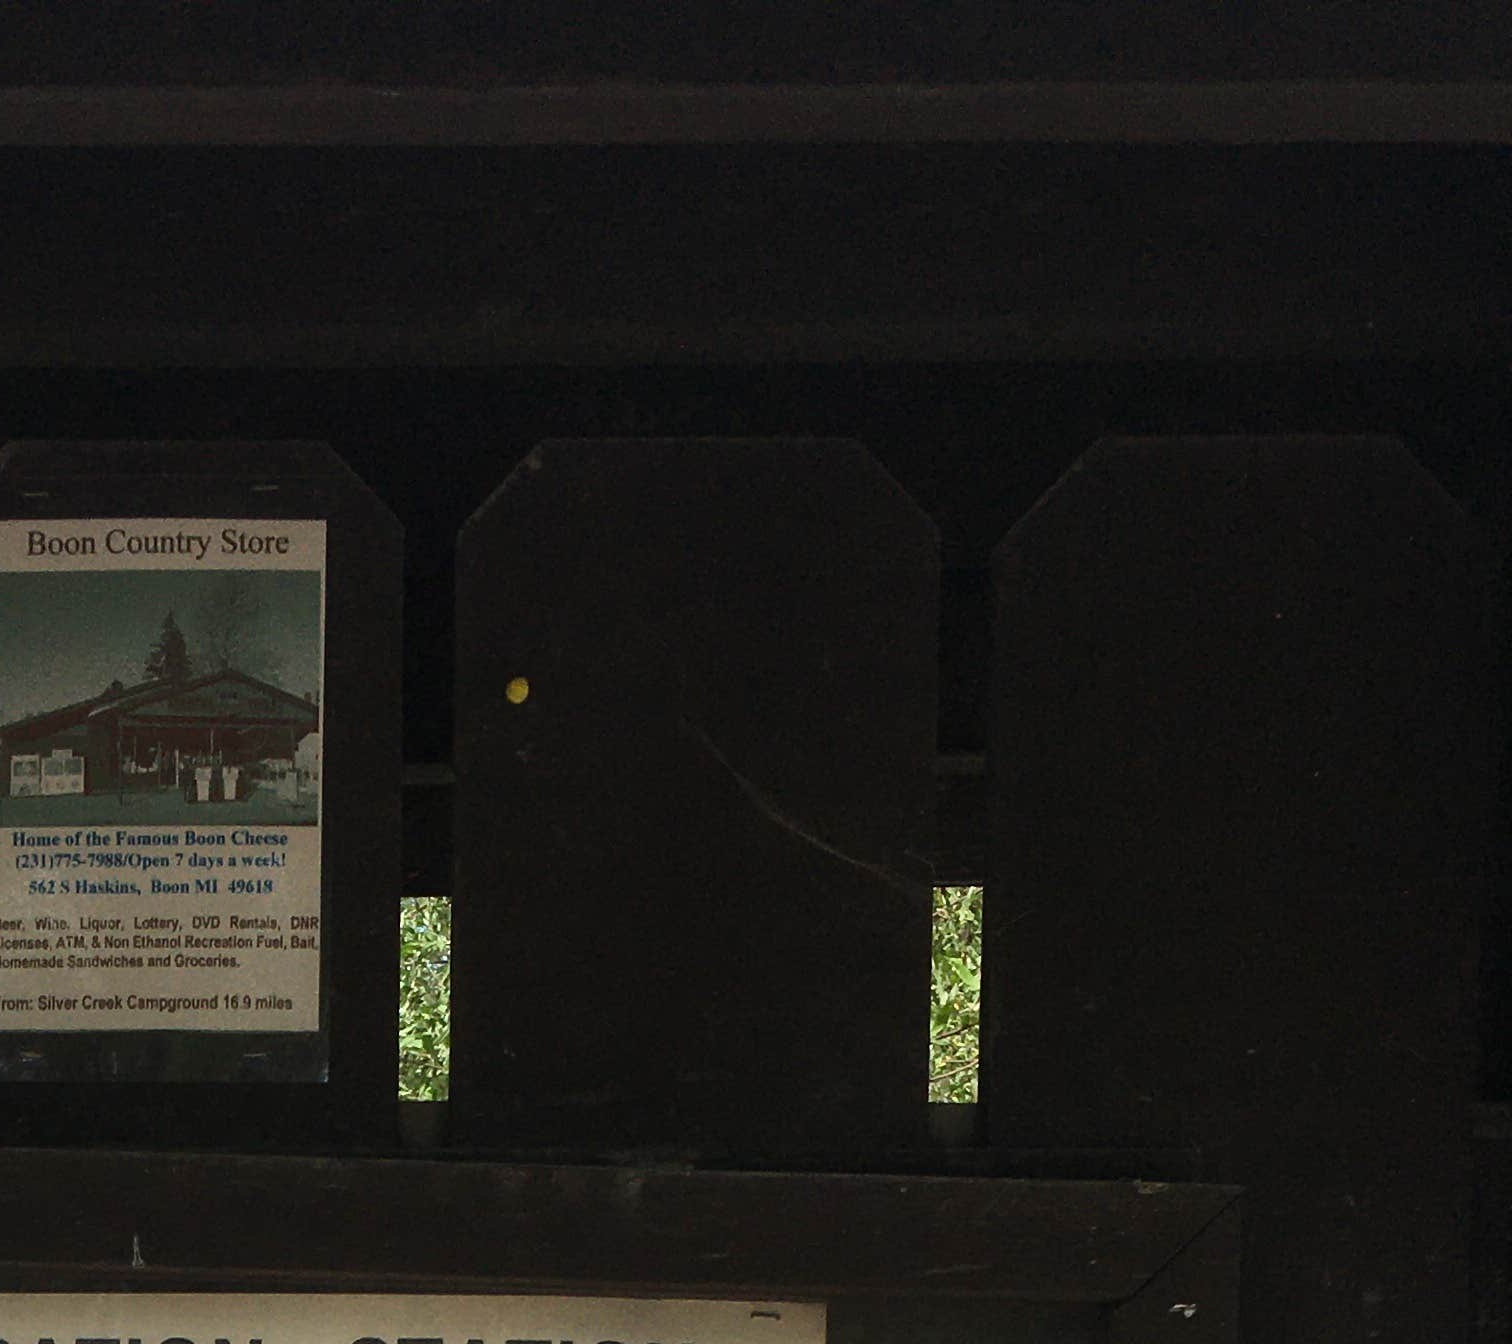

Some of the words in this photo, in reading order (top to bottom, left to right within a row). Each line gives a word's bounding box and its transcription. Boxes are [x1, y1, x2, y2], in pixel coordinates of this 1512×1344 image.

[26, 530, 96, 555] Boon
[104, 528, 212, 560] Country
[220, 528, 290, 554] Store
[227, 856, 237, 867] a
[27, 879, 55, 895] 562
[59, 879, 70, 894] S
[150, 878, 190, 894] Boon
[194, 878, 218, 894] MI
[227, 878, 273, 894] 49618
[37, 994, 78, 1011] Silver
[80, 994, 123, 1010] Creek
[125, 994, 219, 1013] Campground
